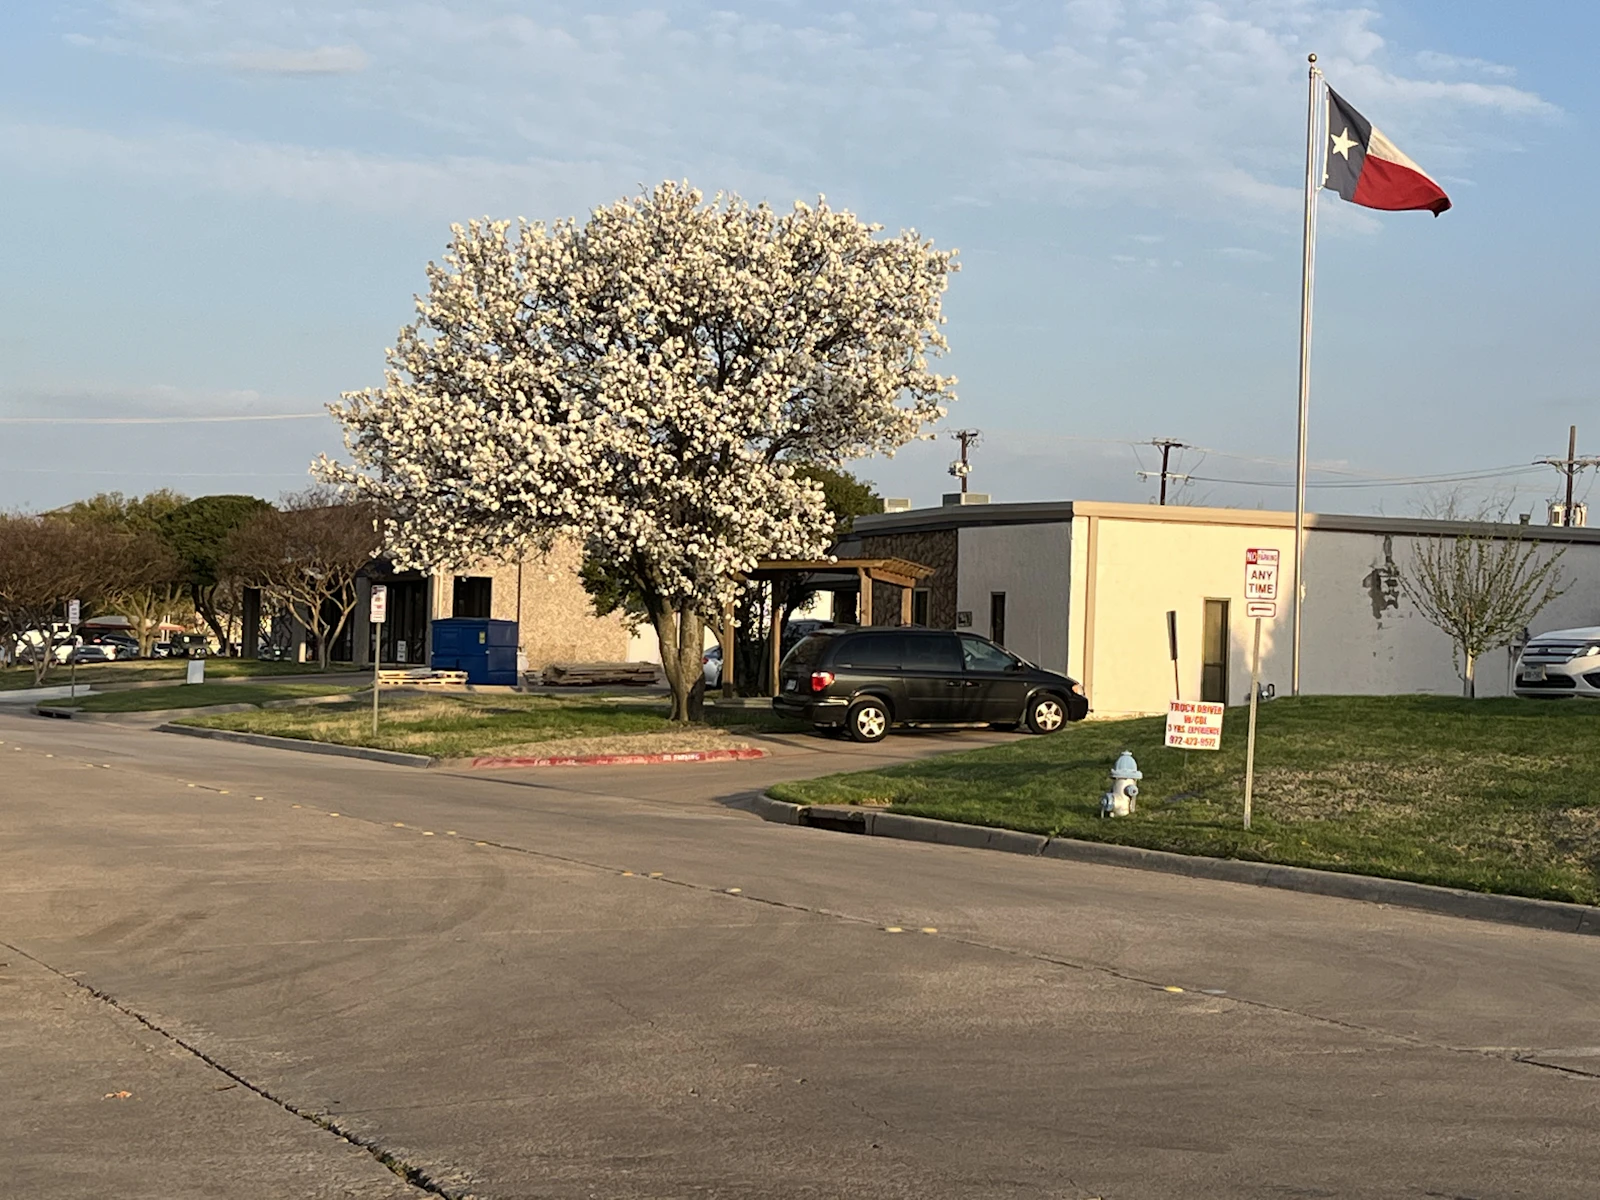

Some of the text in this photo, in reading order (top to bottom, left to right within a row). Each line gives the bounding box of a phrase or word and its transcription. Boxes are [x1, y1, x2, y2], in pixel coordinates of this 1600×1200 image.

[1247, 551, 1256, 562] NO
[1251, 570, 1273, 581] ANY
[1248, 583, 1274, 594] TIME
[1170, 702, 1222, 715] TRUCK DRIVER
